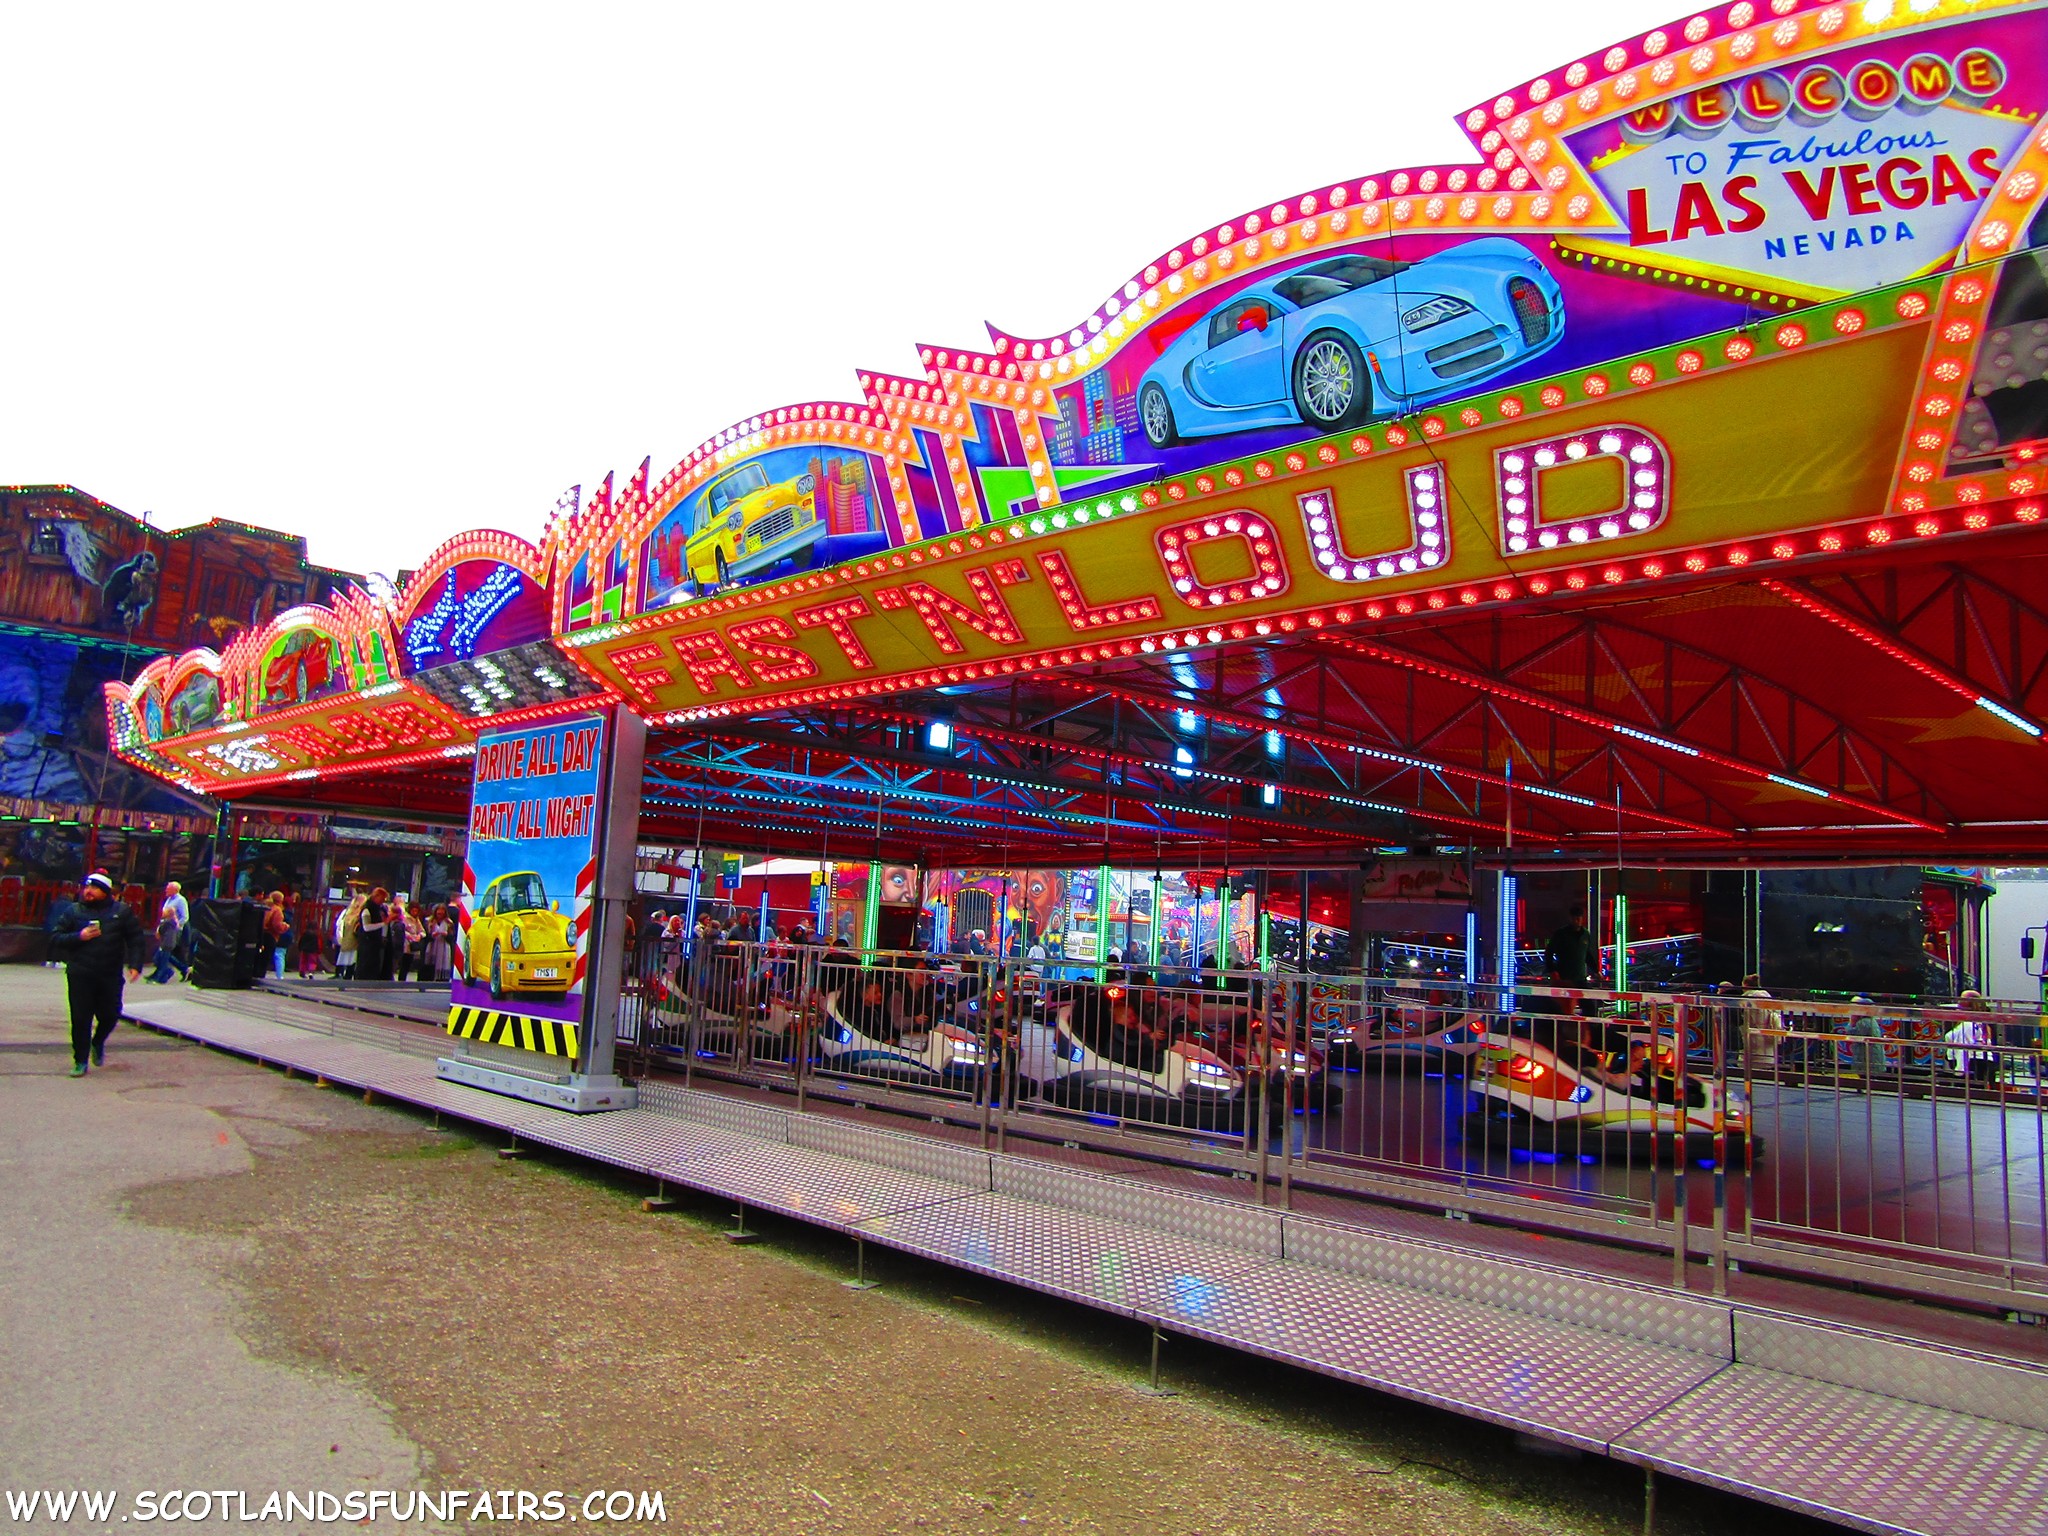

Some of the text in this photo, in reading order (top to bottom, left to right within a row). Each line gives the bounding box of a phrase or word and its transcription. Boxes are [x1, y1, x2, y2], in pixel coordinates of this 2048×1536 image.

[1629, 56, 1992, 128] WELCOME
[1665, 130, 1949, 176] TO Fabulous
[1627, 148, 2002, 247] LAS VEGAS
[1764, 221, 1915, 260] NEVADA
[607, 594, 873, 704] FAST
[1035, 423, 1671, 632] LOUD
[476, 727, 600, 784] DRIVE ALL DAY
[471, 794, 595, 842] PARTY ALL NIGHT
